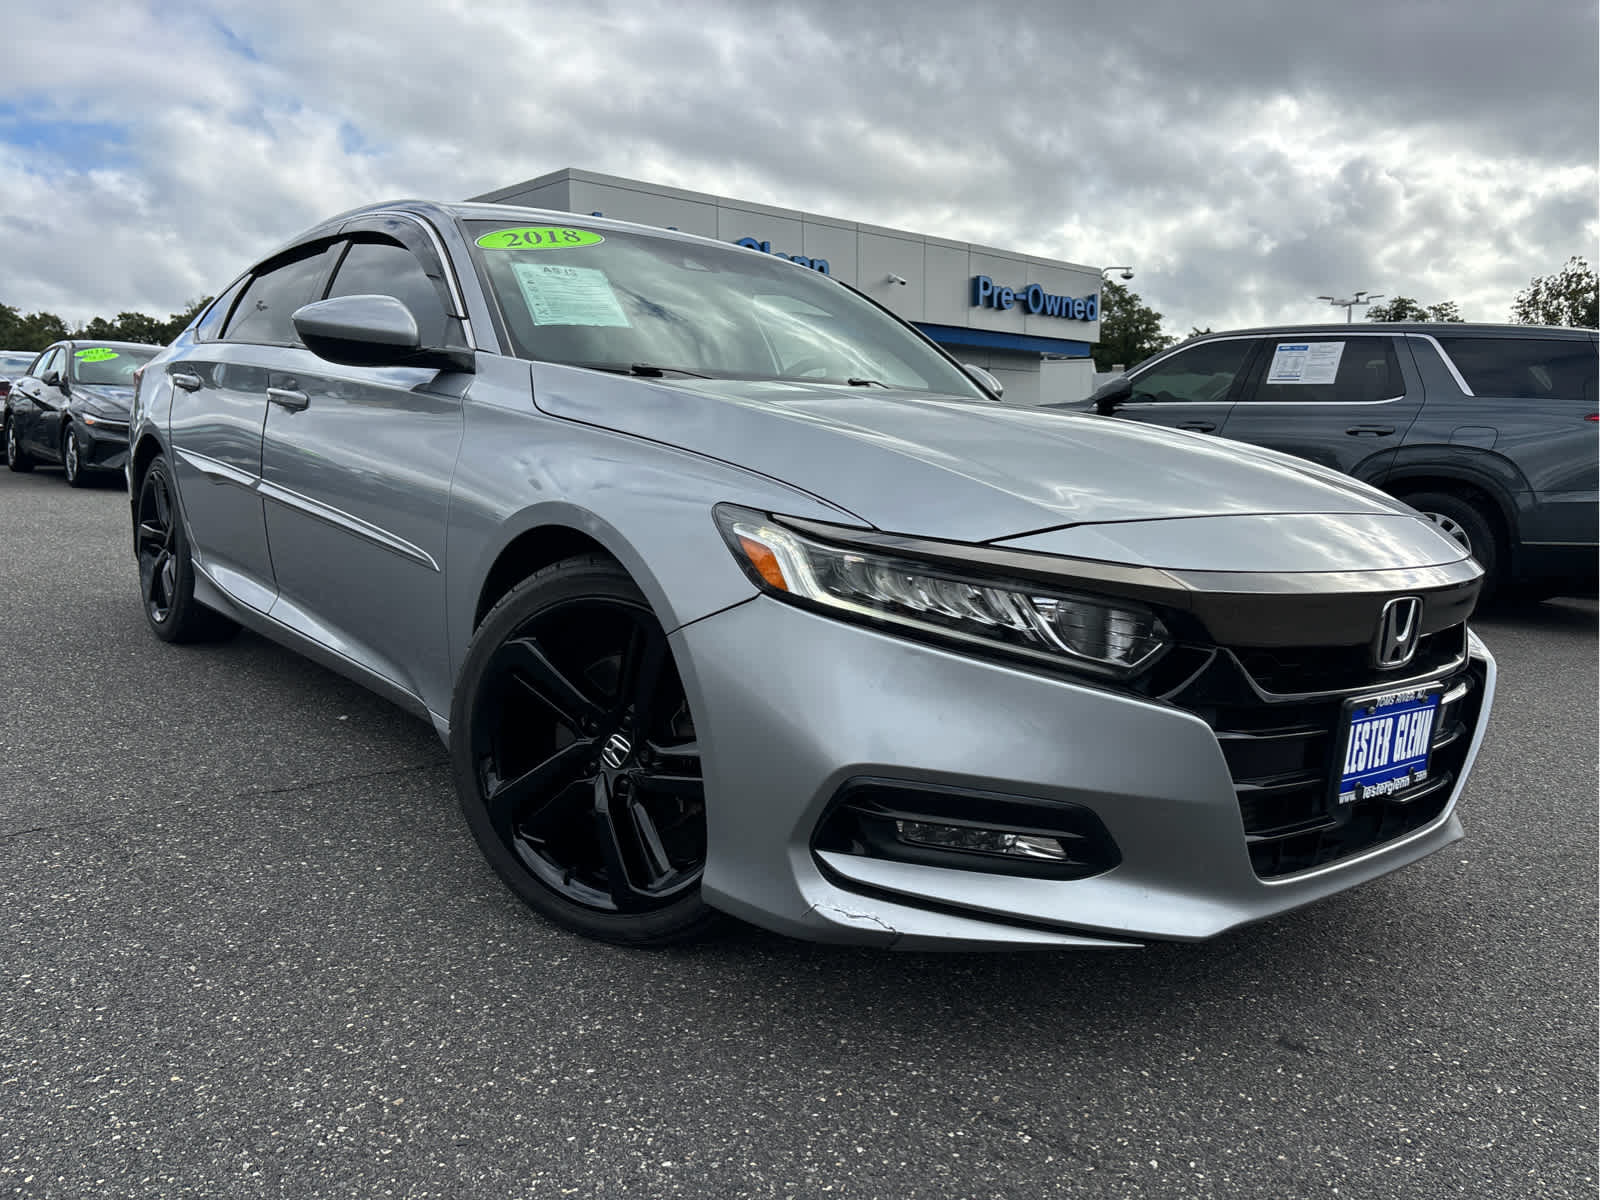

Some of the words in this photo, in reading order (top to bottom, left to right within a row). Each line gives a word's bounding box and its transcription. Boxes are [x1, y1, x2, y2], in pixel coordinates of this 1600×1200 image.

[502, 230, 581, 247] 2018
[973, 275, 1098, 321] Pre-Owned
[1343, 718, 1393, 775] LESTER
[1393, 708, 1435, 763] GLENN
